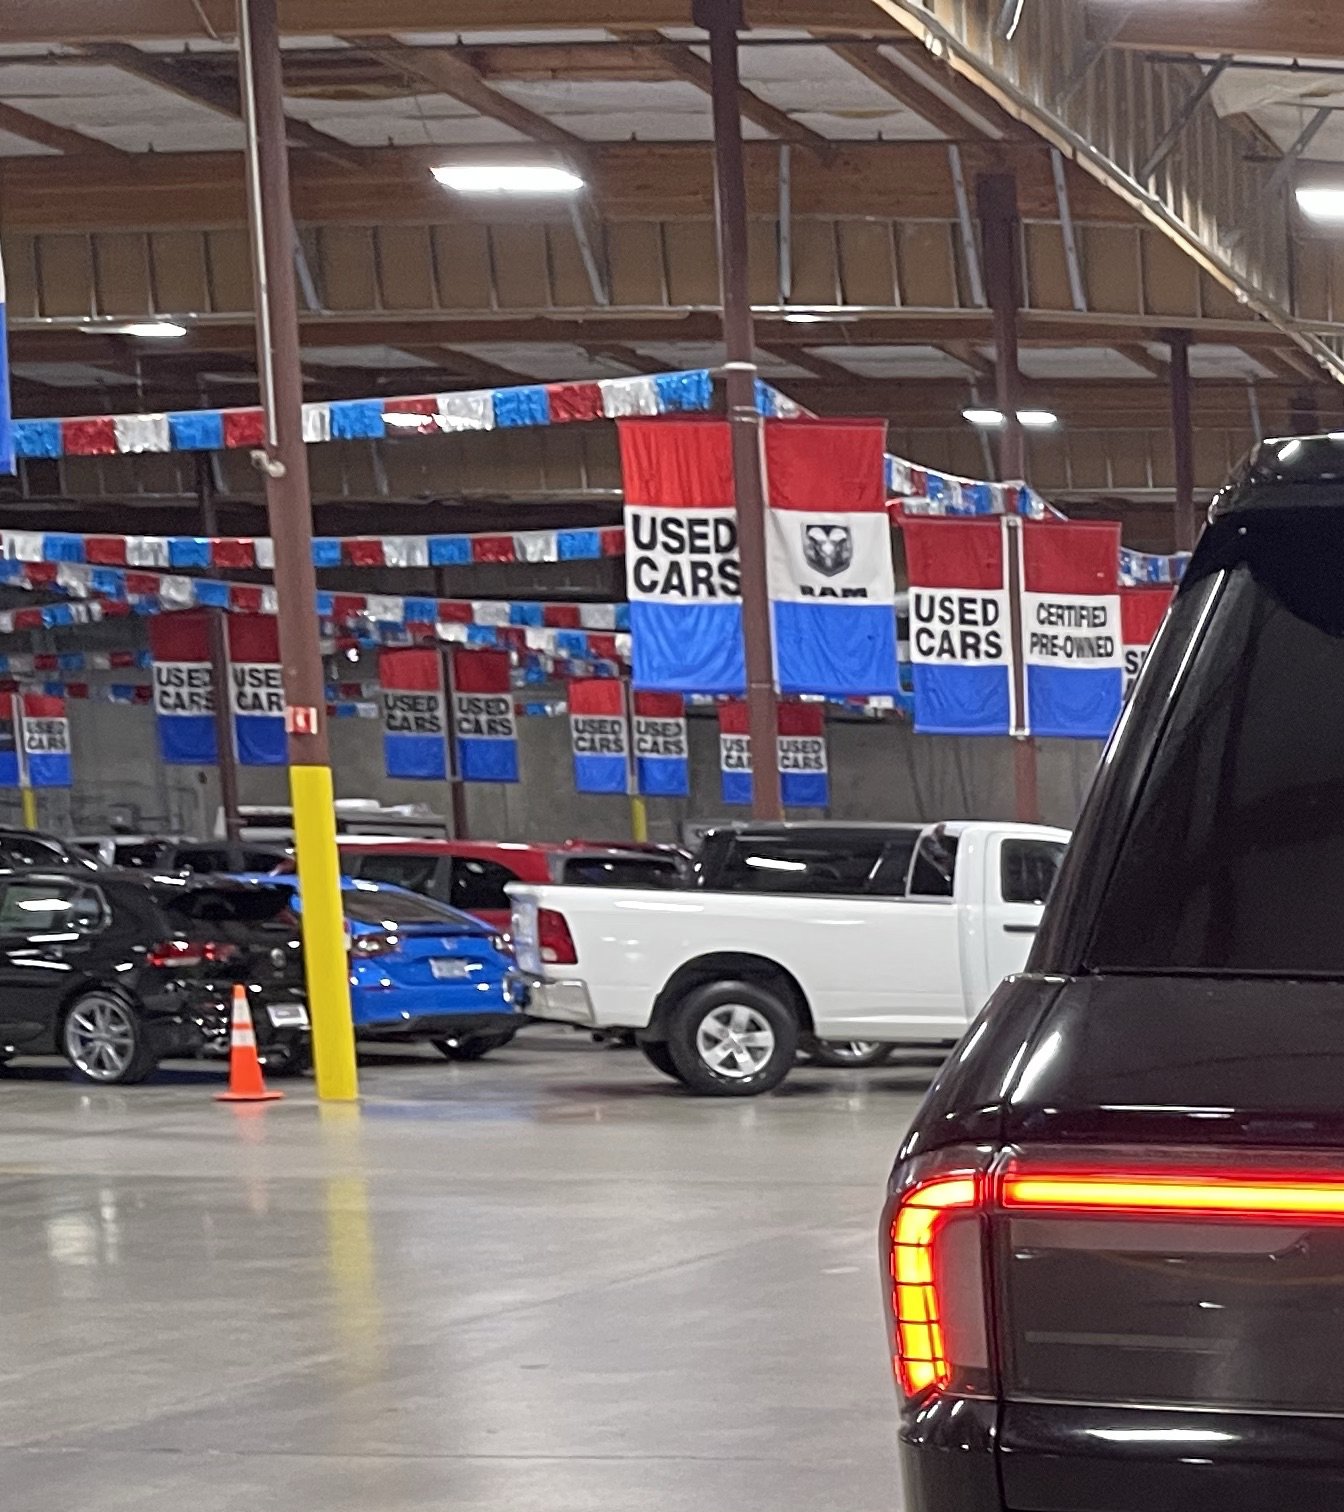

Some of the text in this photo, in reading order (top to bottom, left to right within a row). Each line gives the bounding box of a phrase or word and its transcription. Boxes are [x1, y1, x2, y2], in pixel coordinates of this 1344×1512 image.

[632, 514, 736, 554] USED
[633, 556, 741, 597] CARS
[914, 594, 999, 626] USED
[1037, 603, 1106, 628] CERTIFIED
[916, 628, 1002, 659] CARS
[1030, 633, 1114, 658] PRE-OWNED
[232, 668, 282, 688] USE
[237, 691, 284, 711] CAR
[384, 694, 439, 712] USED
[459, 697, 510, 716] USED
[386, 715, 442, 732] CARS
[458, 717, 513, 736] CARS
[574, 719, 622, 734] USED
[637, 720, 683, 736] USED
[574, 737, 624, 752] CARS
[637, 738, 684, 754] CARS
[780, 740, 821, 753] USED
[781, 756, 823, 769] CARS
